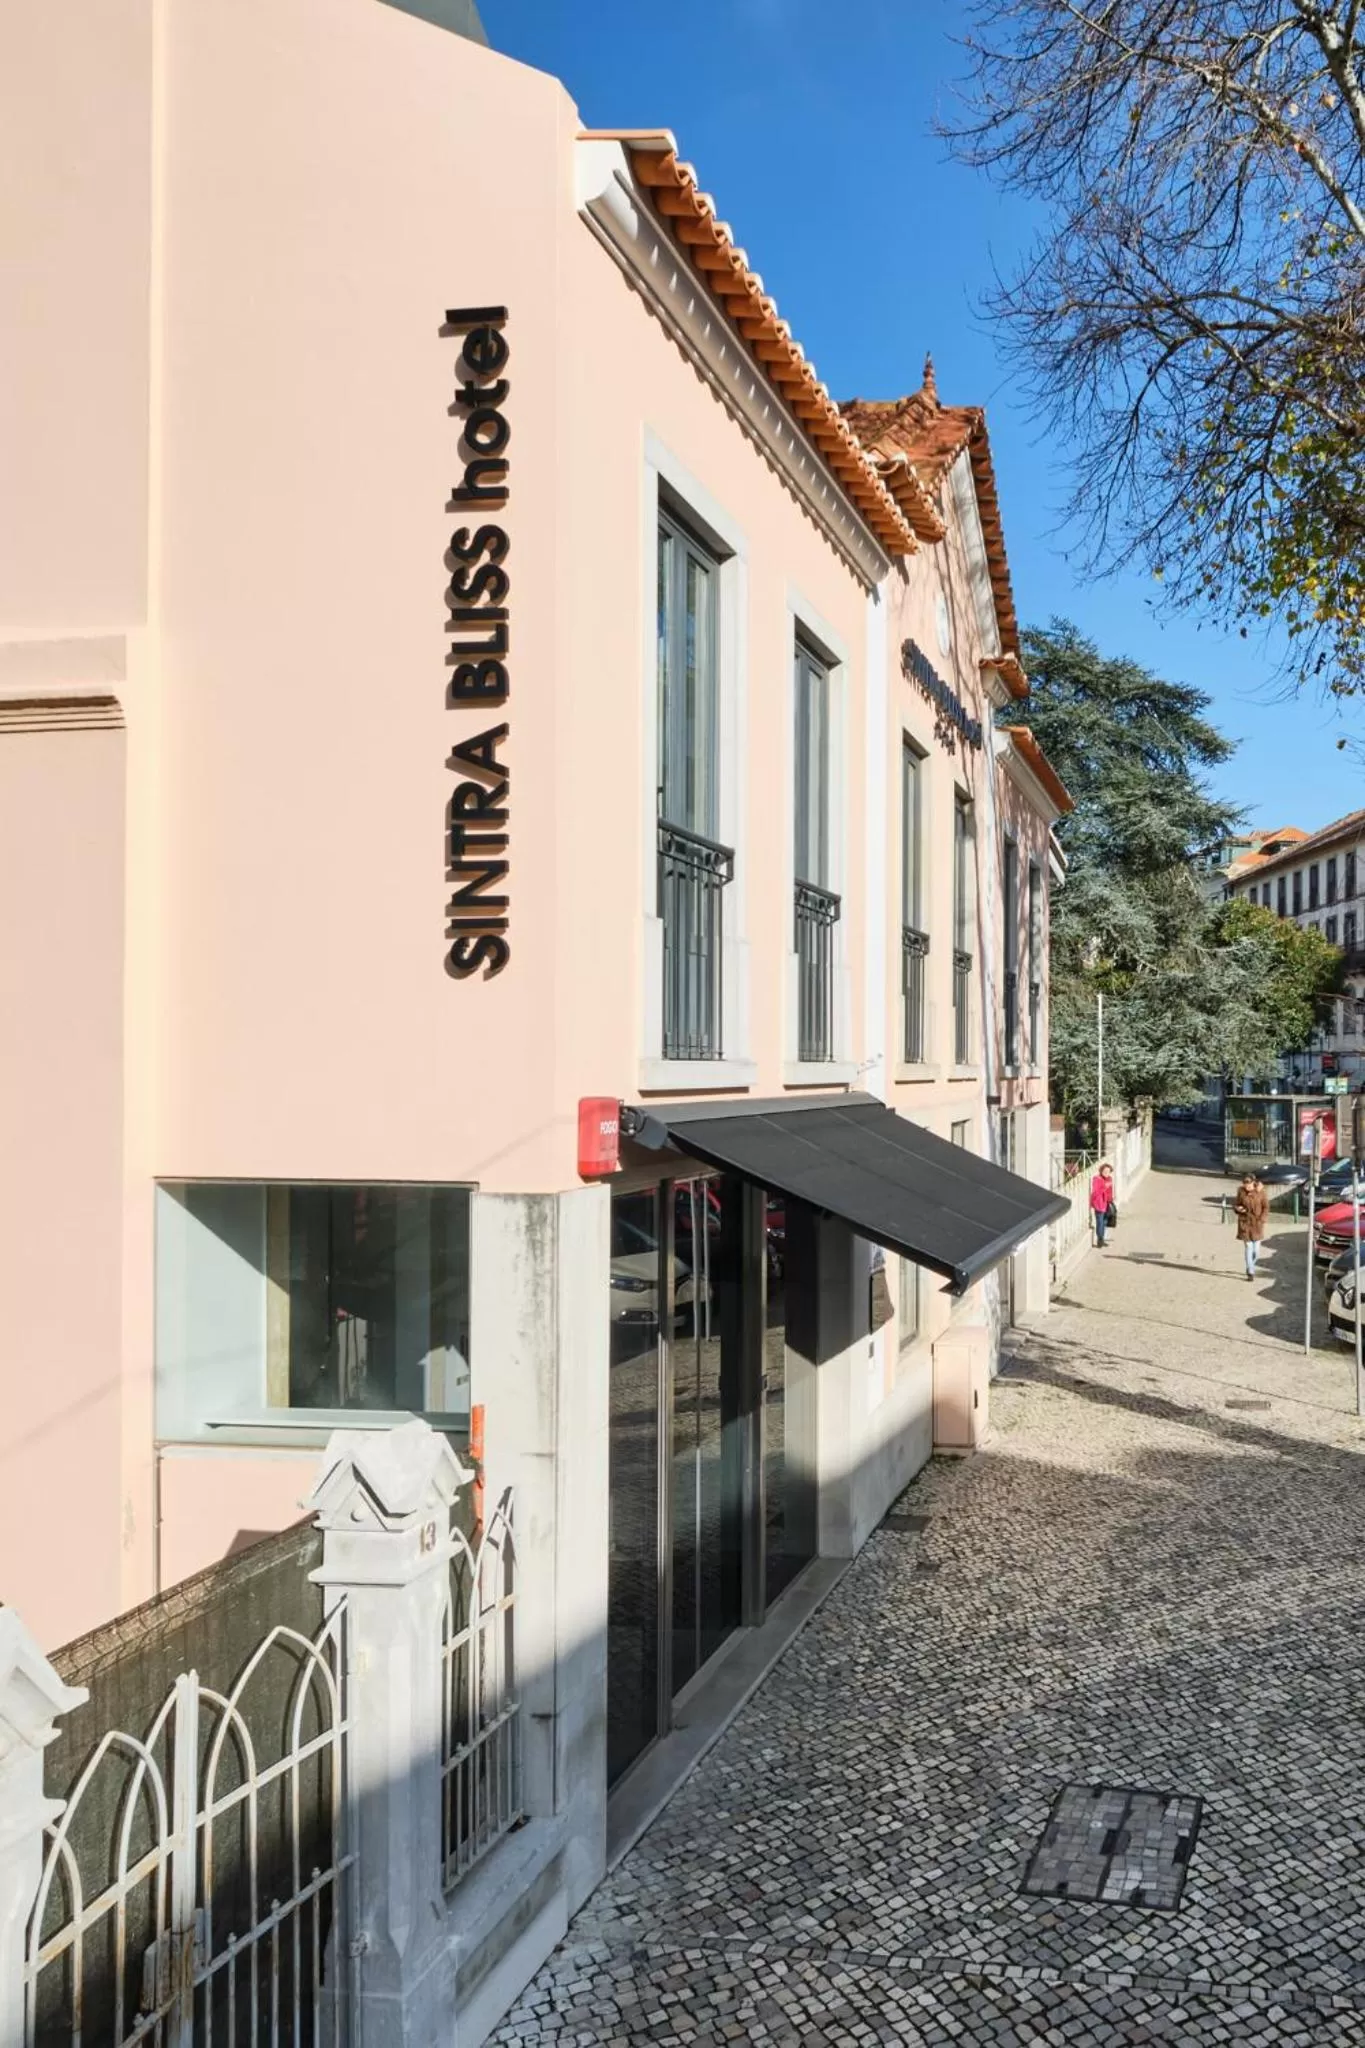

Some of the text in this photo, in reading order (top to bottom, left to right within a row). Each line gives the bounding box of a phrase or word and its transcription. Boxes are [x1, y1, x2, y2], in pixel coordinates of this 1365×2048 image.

[445, 306, 509, 981] SINTRA BLISS hotel
[420, 1521, 436, 1553] 13
